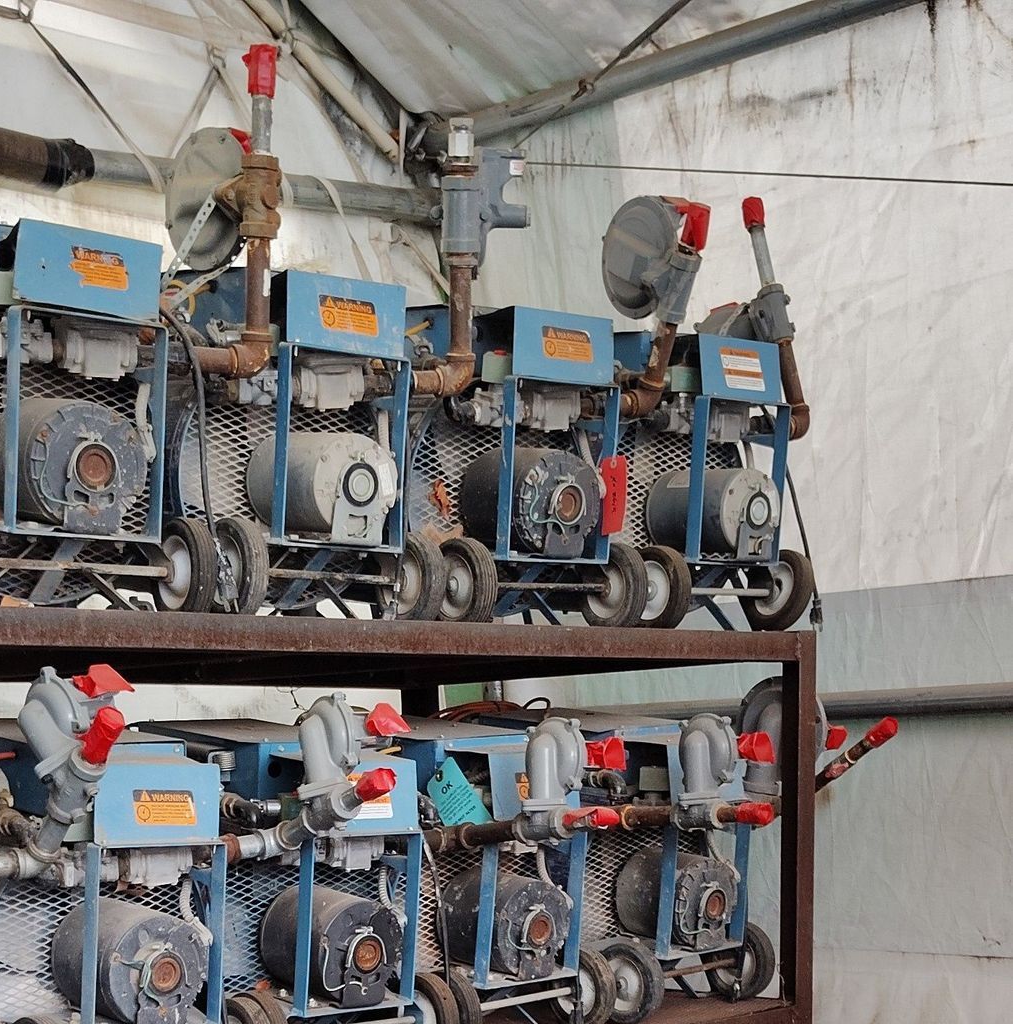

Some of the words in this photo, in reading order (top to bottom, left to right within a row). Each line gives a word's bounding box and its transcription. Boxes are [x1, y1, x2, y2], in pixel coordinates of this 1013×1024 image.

[336, 301, 373, 314] WARNING
[441, 780, 453, 794] OK
[151, 793, 190, 802] WARNING
